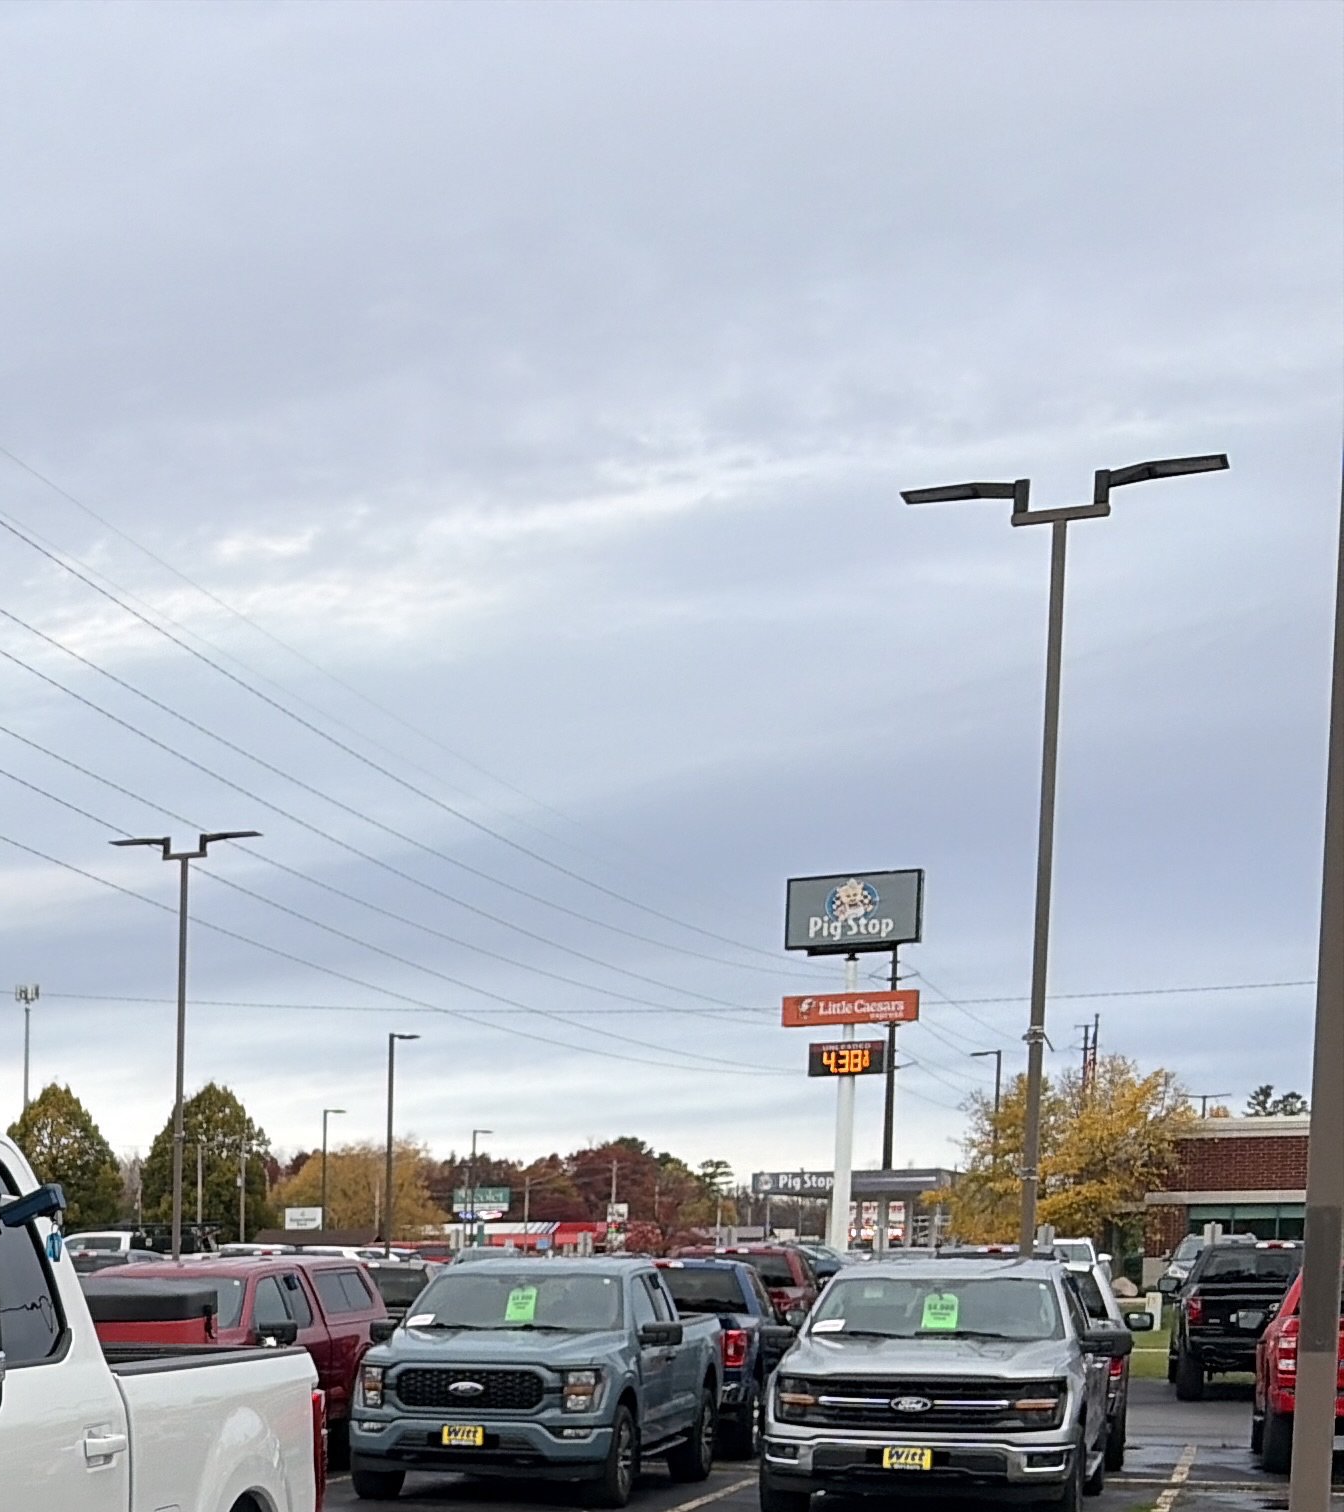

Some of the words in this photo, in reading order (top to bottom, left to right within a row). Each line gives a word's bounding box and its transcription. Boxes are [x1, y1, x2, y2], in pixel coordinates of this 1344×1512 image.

[809, 916, 842, 941] Pig
[846, 916, 894, 938] Stop
[818, 1000, 854, 1016] Little
[854, 999, 905, 1014] Caesars
[779, 1174, 801, 1191] Pig
[803, 1173, 834, 1189] Stop
[449, 1426, 478, 1438] Witt
[888, 1449, 925, 1462] Witt
